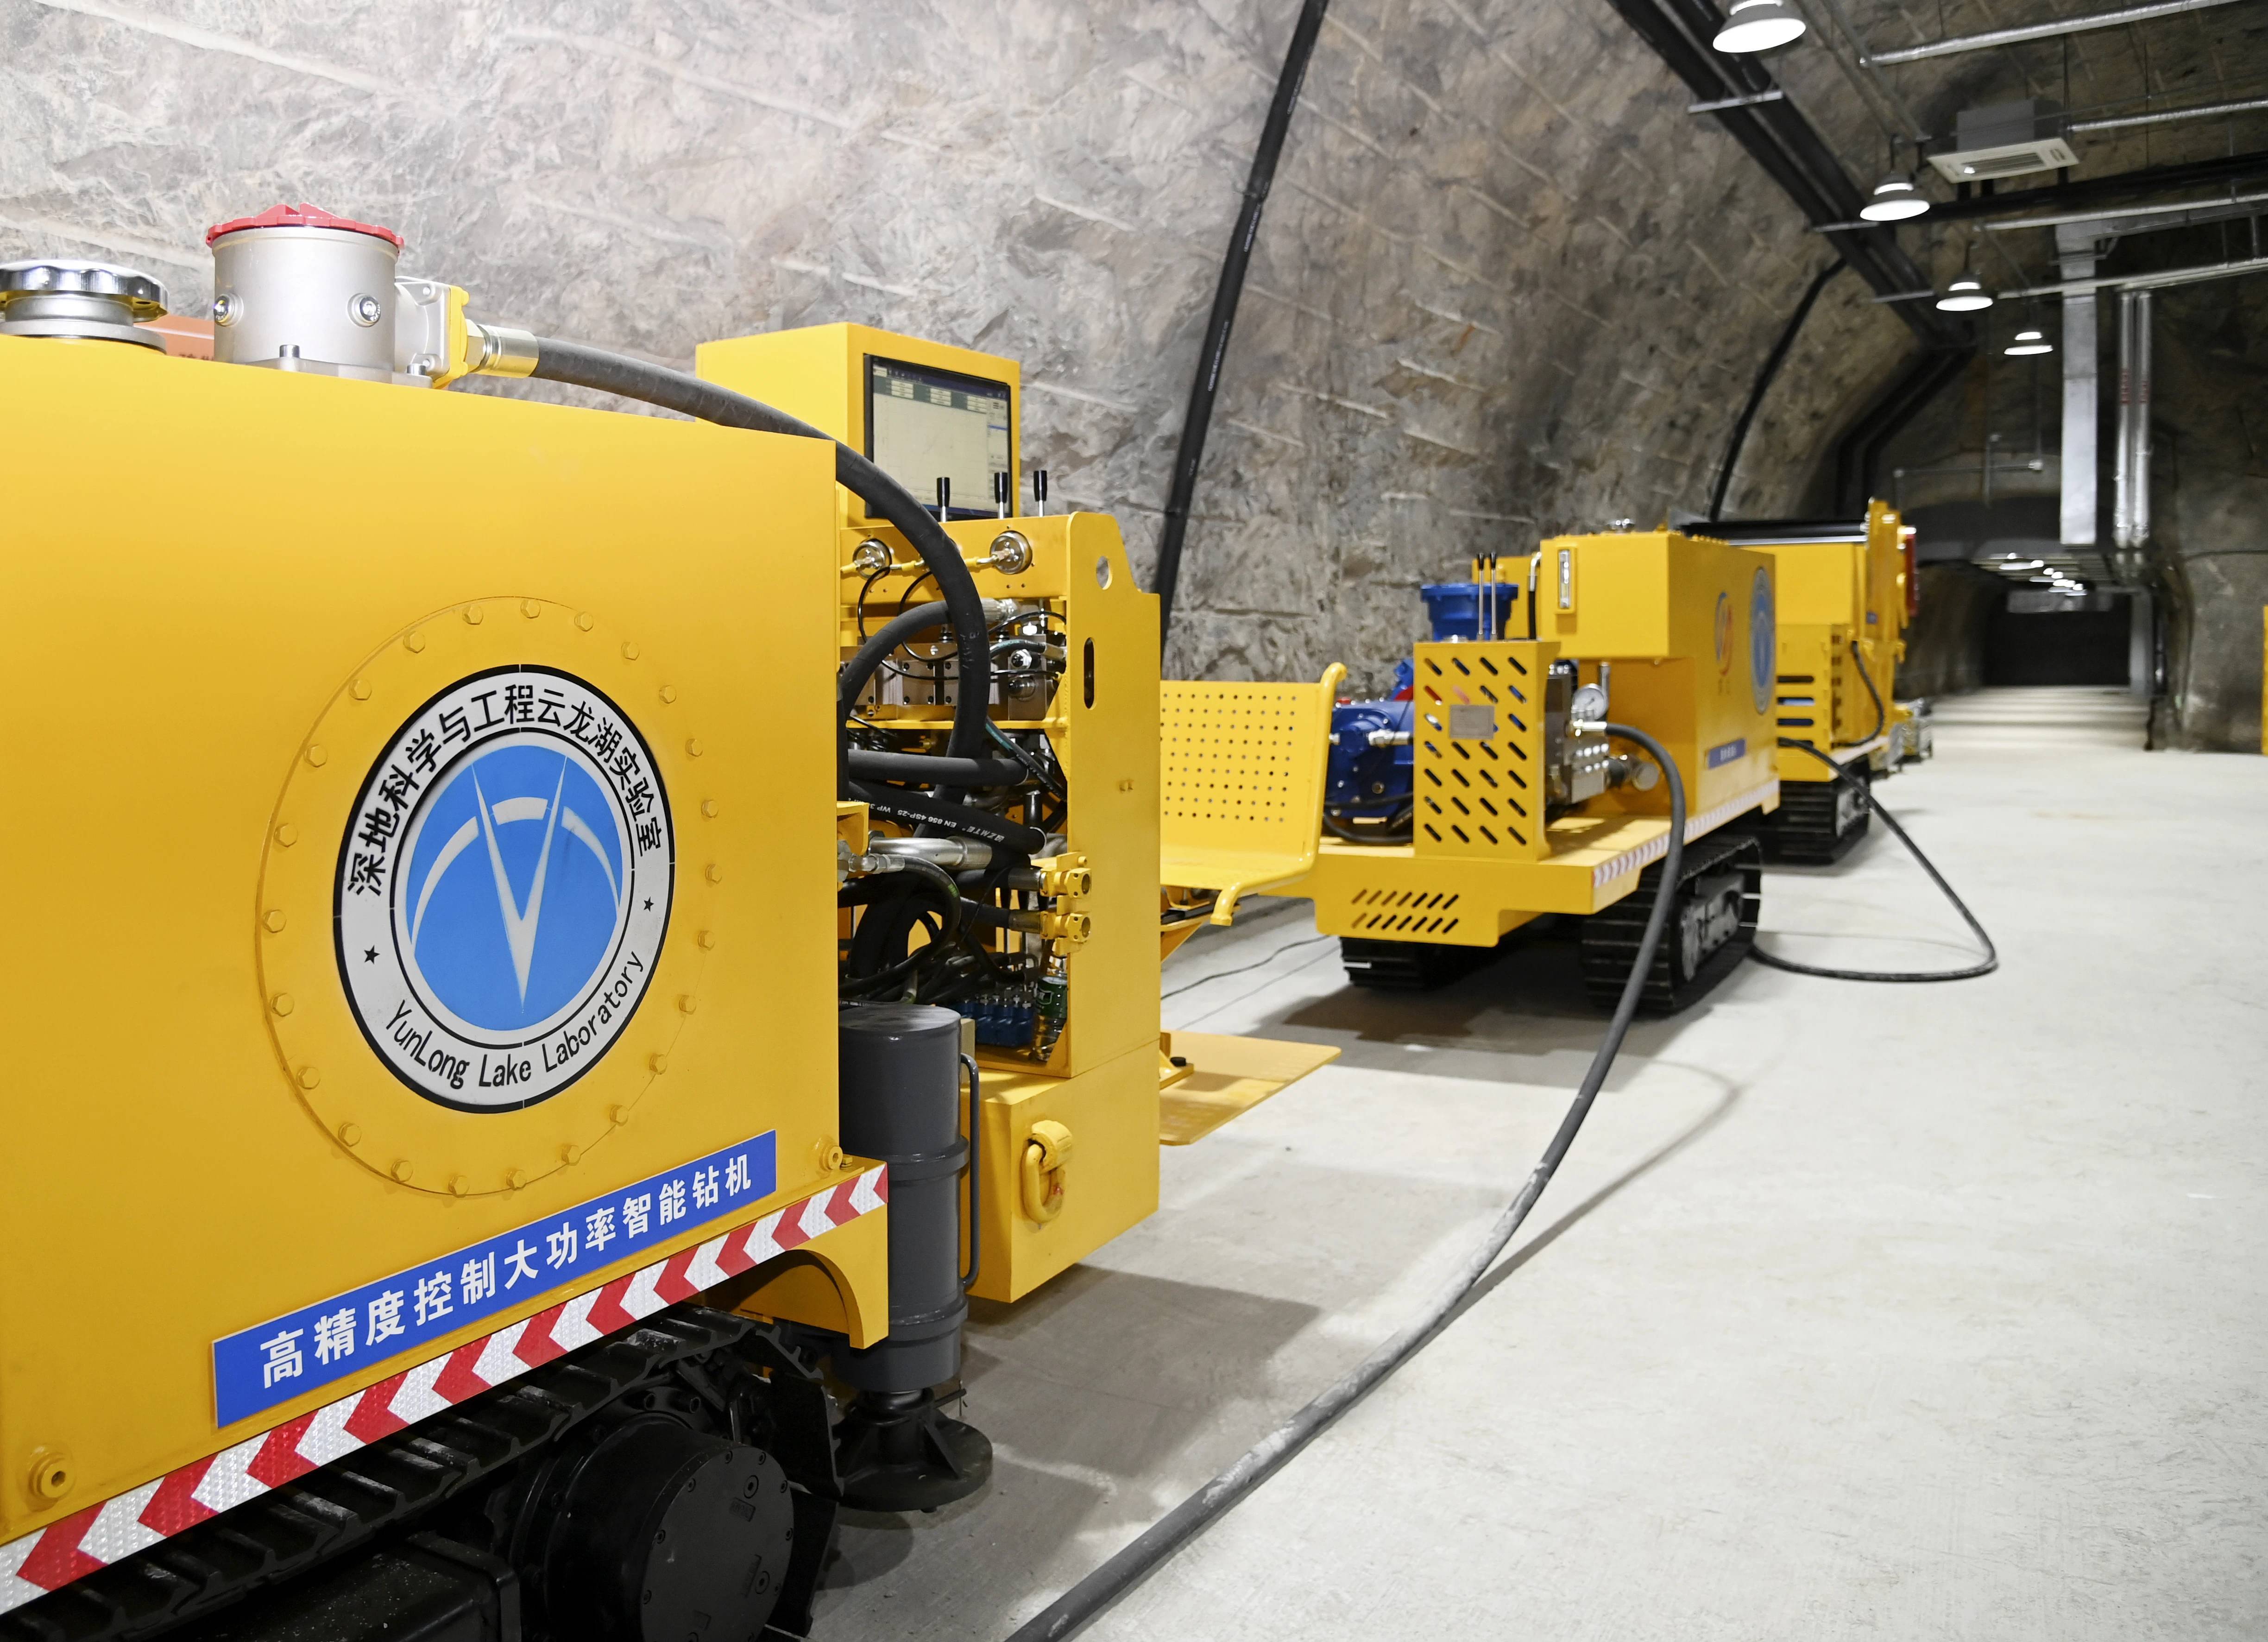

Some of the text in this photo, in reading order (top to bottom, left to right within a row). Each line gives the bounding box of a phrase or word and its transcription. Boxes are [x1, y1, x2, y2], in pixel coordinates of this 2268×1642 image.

[347, 683, 662, 897] 深地科学与工程云龙湖实验室
[897, 809, 927, 821] 4SP-25
[927, 816, 943, 825] 856
[385, 951, 644, 1090] YunLong Lake Laboratory
[259, 1154, 752, 1389] 高精度控制大功率智能钻机
